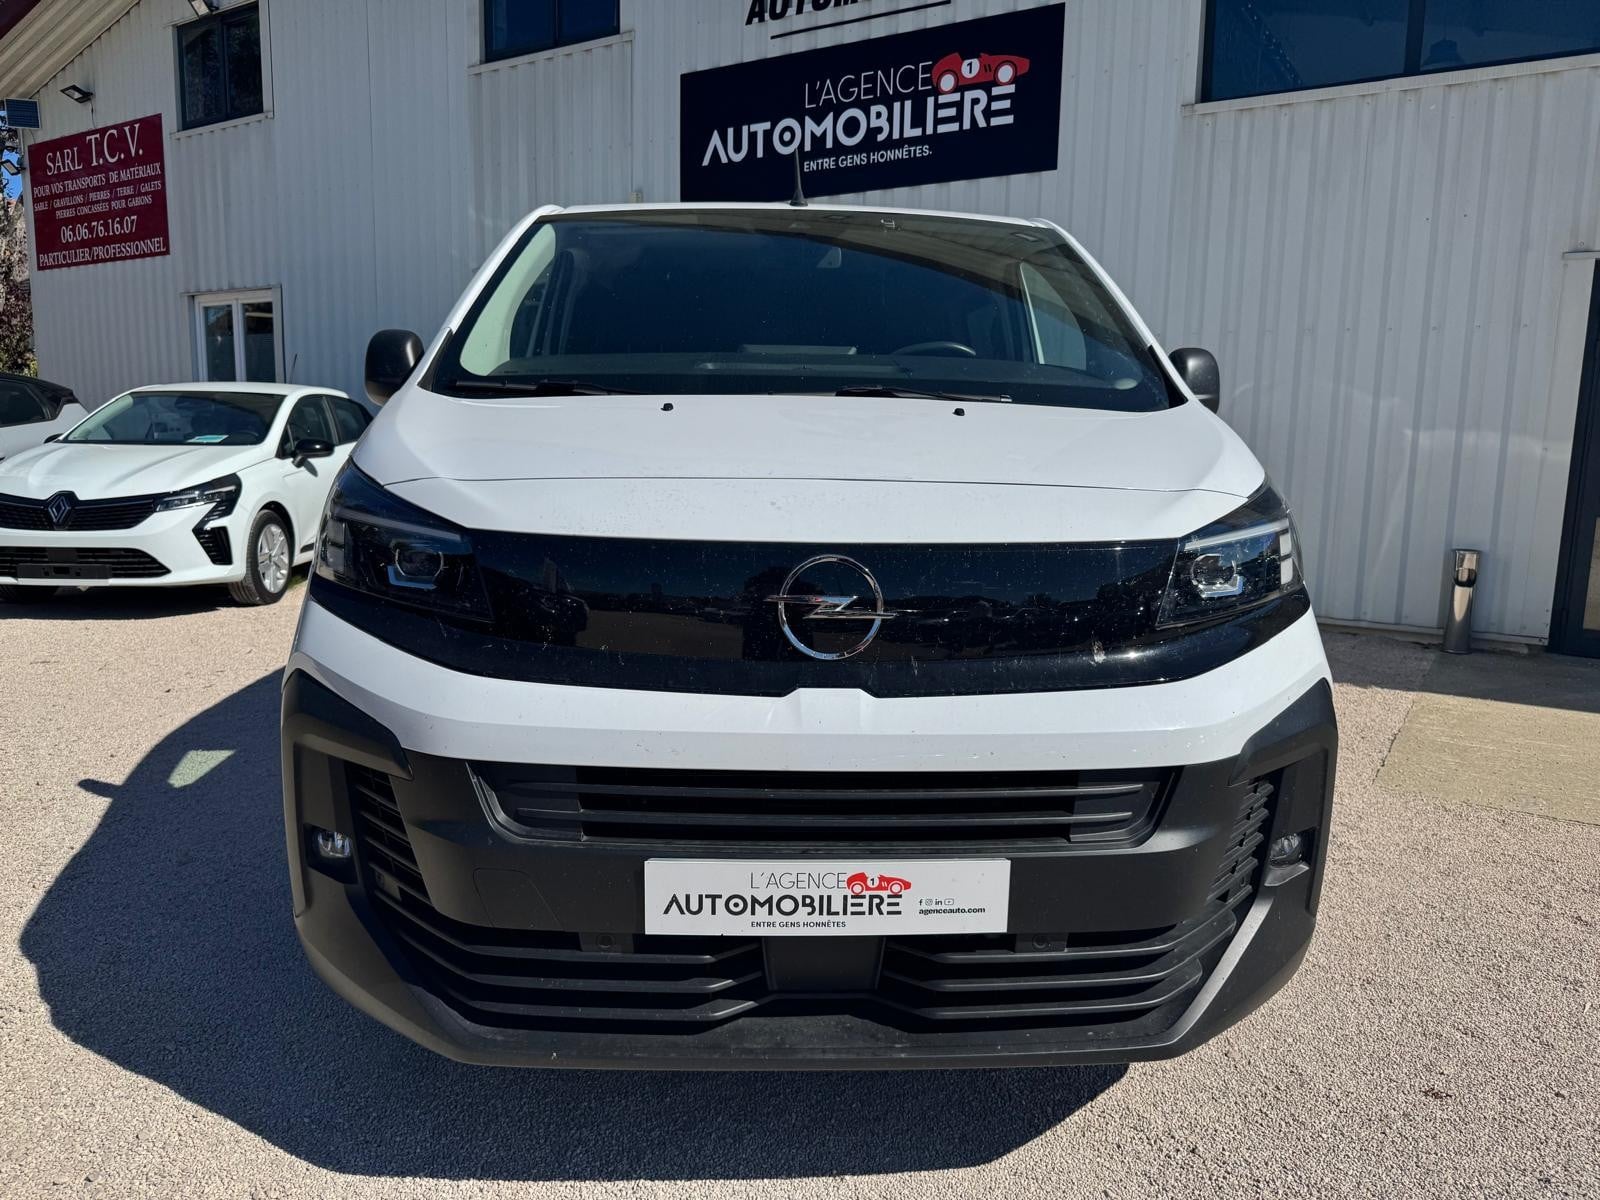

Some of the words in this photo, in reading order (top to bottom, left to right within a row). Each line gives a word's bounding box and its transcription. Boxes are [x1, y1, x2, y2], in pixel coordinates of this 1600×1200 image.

[804, 61, 933, 109] L'AGENCE
[966, 61, 973, 74] 1
[46, 147, 83, 176] SARL
[803, 157, 836, 172] ENTRE
[838, 153, 867, 168] GENS
[870, 145, 933, 164] HONNÊTES.
[33, 184, 51, 198] POUR
[50, 182, 64, 195] VOS
[64, 173, 106, 192] TRANSPORTS
[109, 171, 119, 183] DE
[119, 162, 161, 182] MATÉRIAUX
[34, 201, 48, 211] SABLE
[53, 194, 84, 208] GRAVILLONS
[89, 189, 110, 202] PIERRES
[117, 185, 134, 197] TERRE
[140, 180, 161, 192] GALETS
[55, 208, 75, 219] PIERRES
[111, 199, 126, 210] POUR
[60, 215, 137, 244] 06.06.76.16.07
[750, 872, 847, 889] L'AGENCE
[802, 919, 846, 928] HONNÊTES
[918, 907, 986, 916] agenceauto.com
